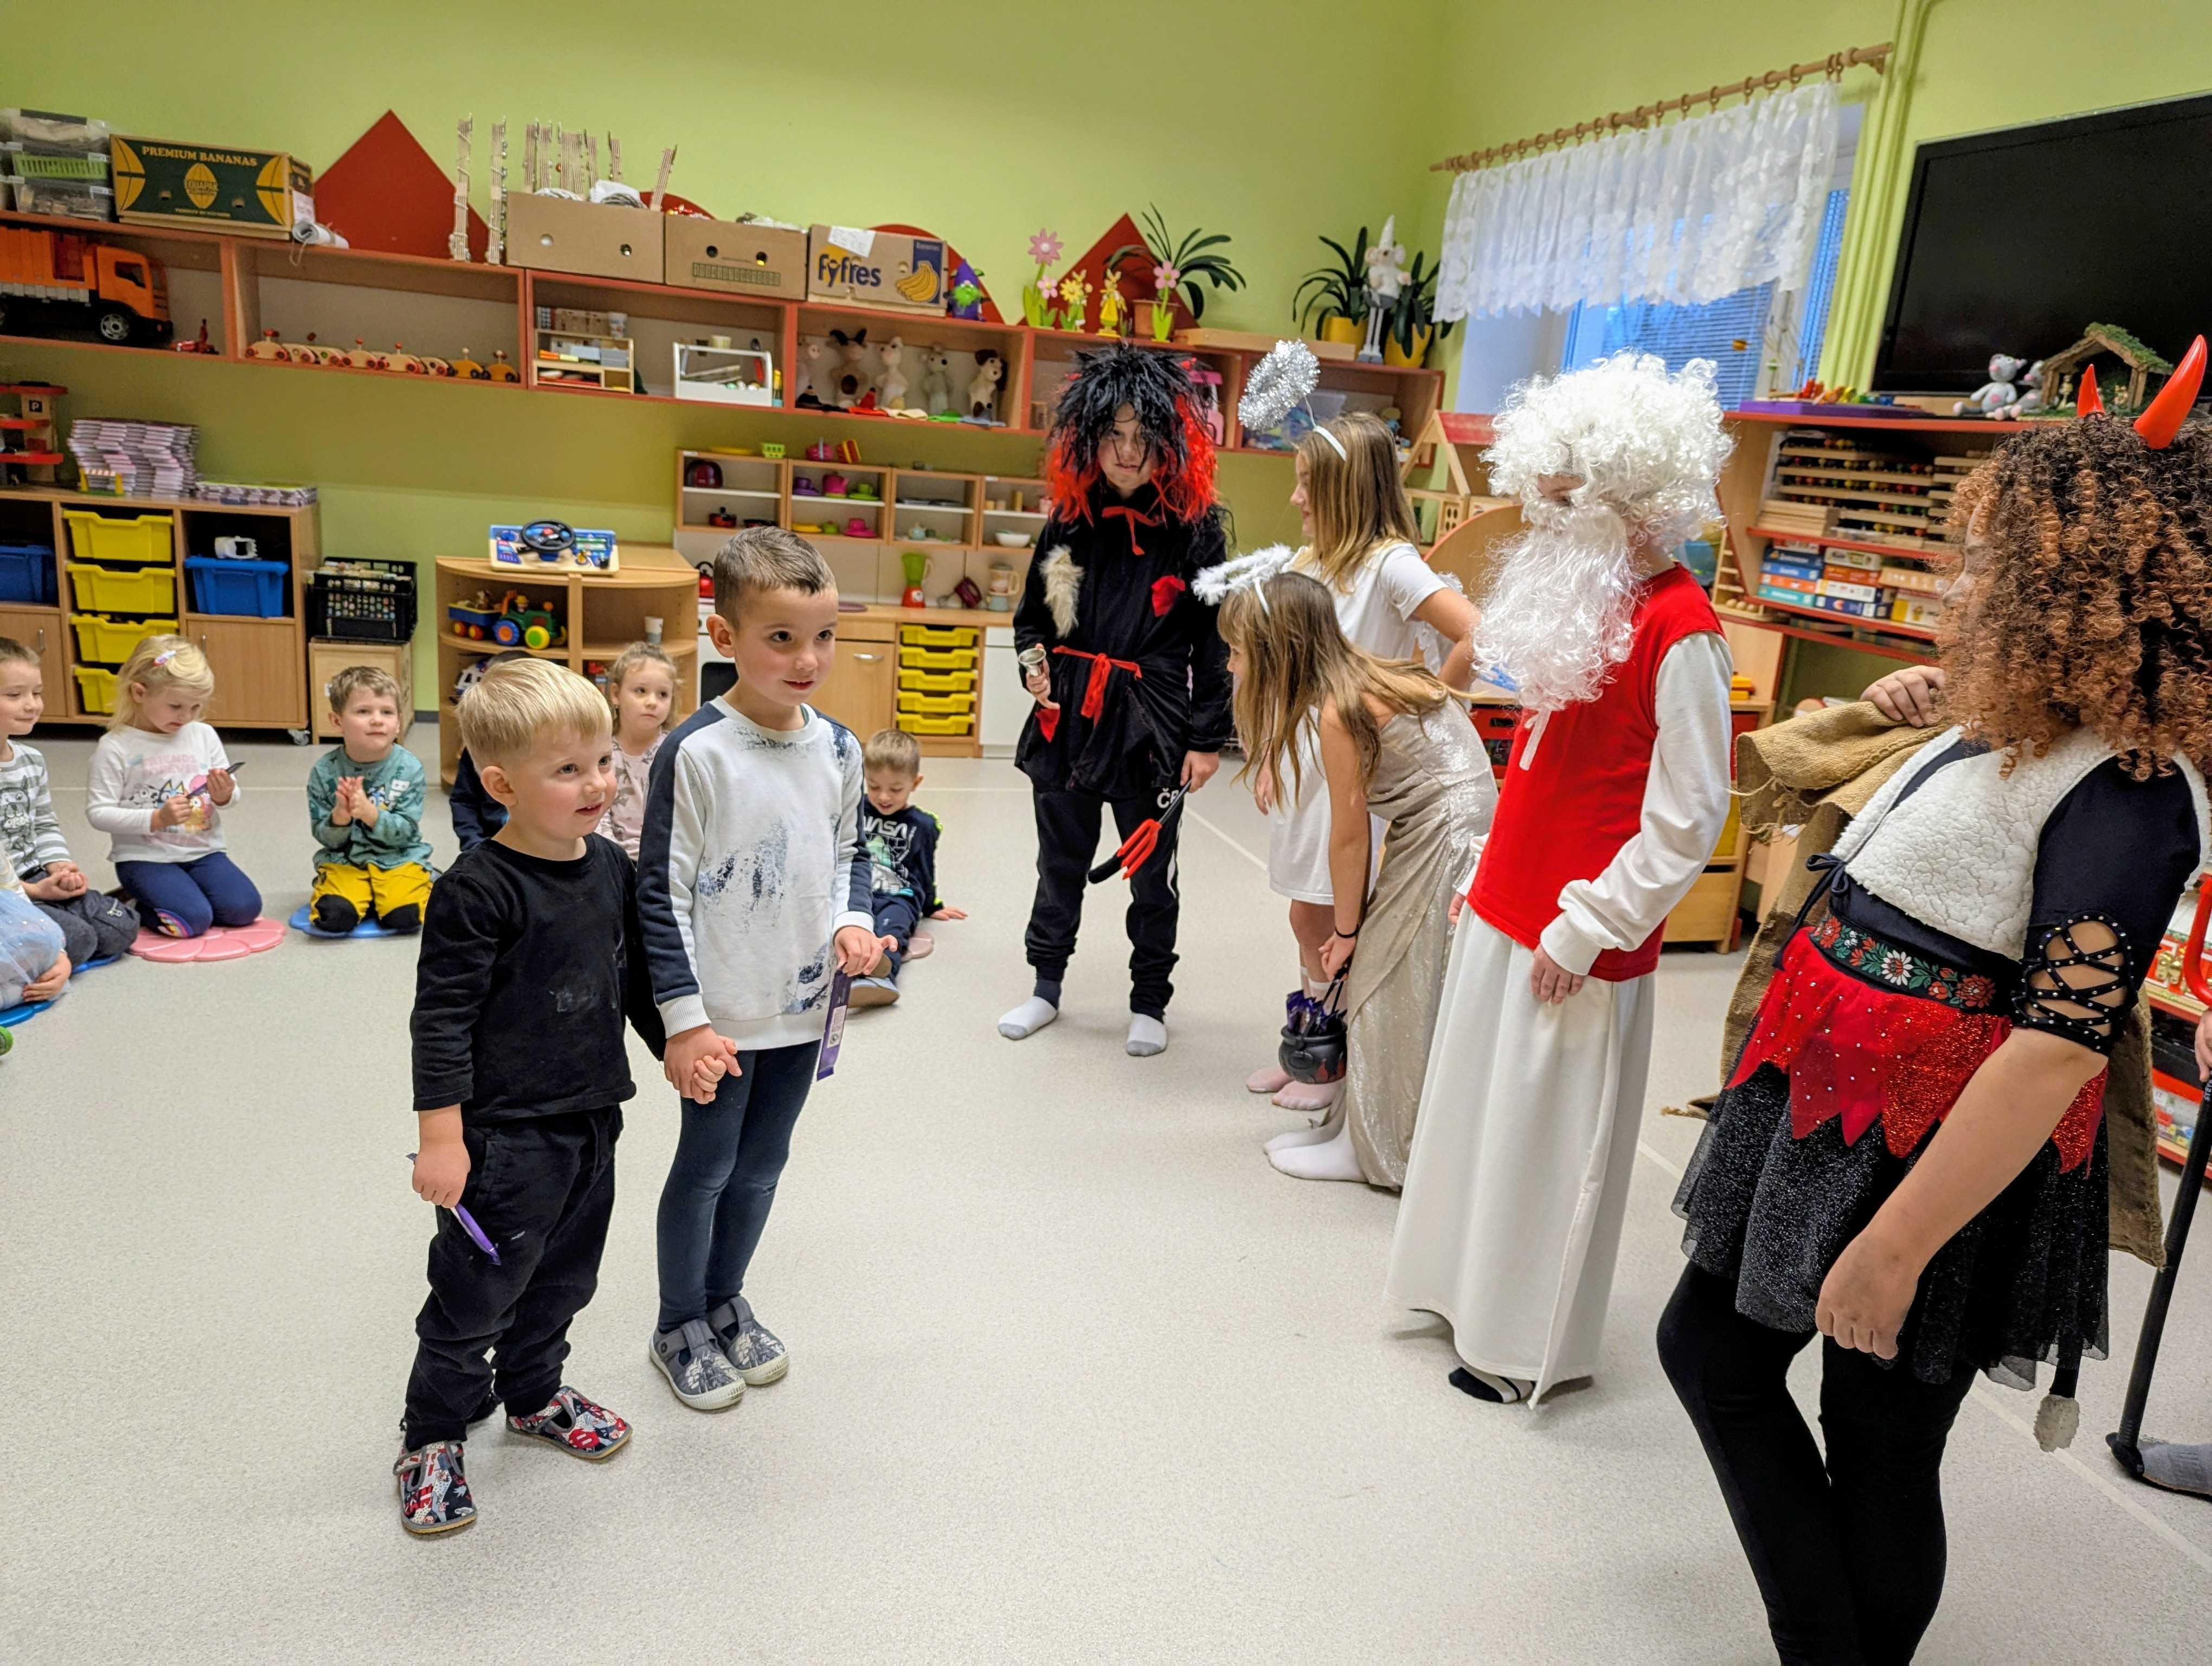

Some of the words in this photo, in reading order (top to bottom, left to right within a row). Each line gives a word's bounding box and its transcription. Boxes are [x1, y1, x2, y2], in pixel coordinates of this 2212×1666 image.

[142, 146, 197, 161] PREMIUM
[199, 151, 258, 166] BANANAS
[863, 815, 908, 840] NASA
